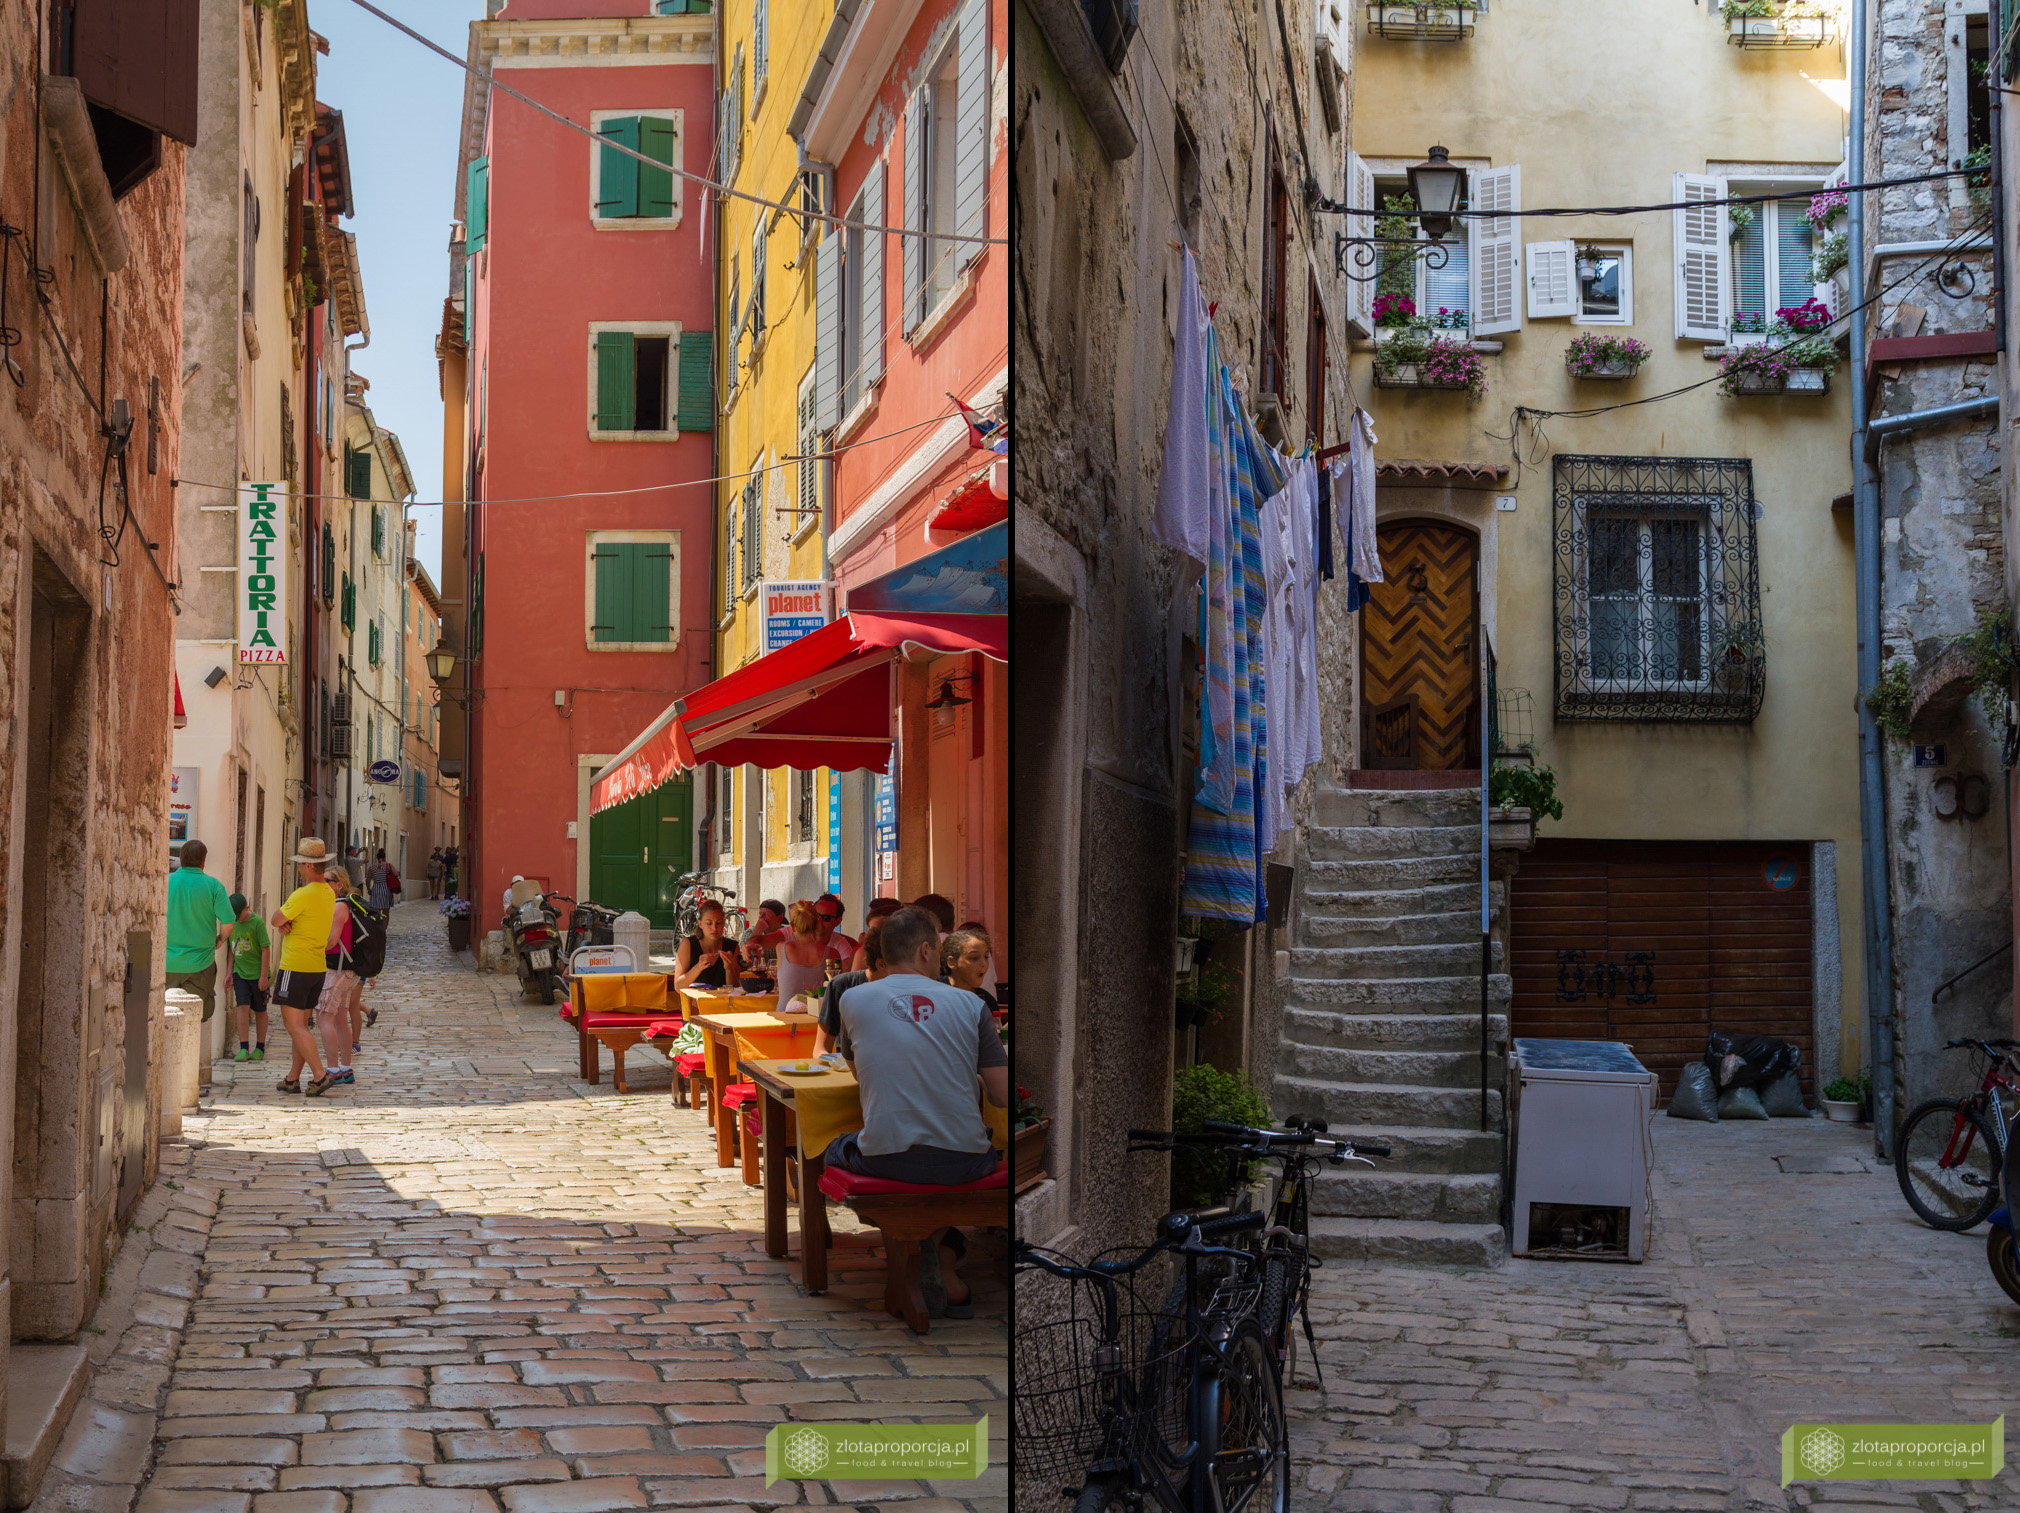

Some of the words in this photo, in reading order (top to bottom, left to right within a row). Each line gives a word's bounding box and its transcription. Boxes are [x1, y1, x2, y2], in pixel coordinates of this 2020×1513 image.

[248, 484, 277, 647] TRATTORIA
[768, 592, 822, 616] planet
[770, 629, 802, 637] EXCURSION
[240, 650, 285, 662] PIZZA
[1924, 745, 1936, 760] 5
[589, 956, 612, 967] planet
